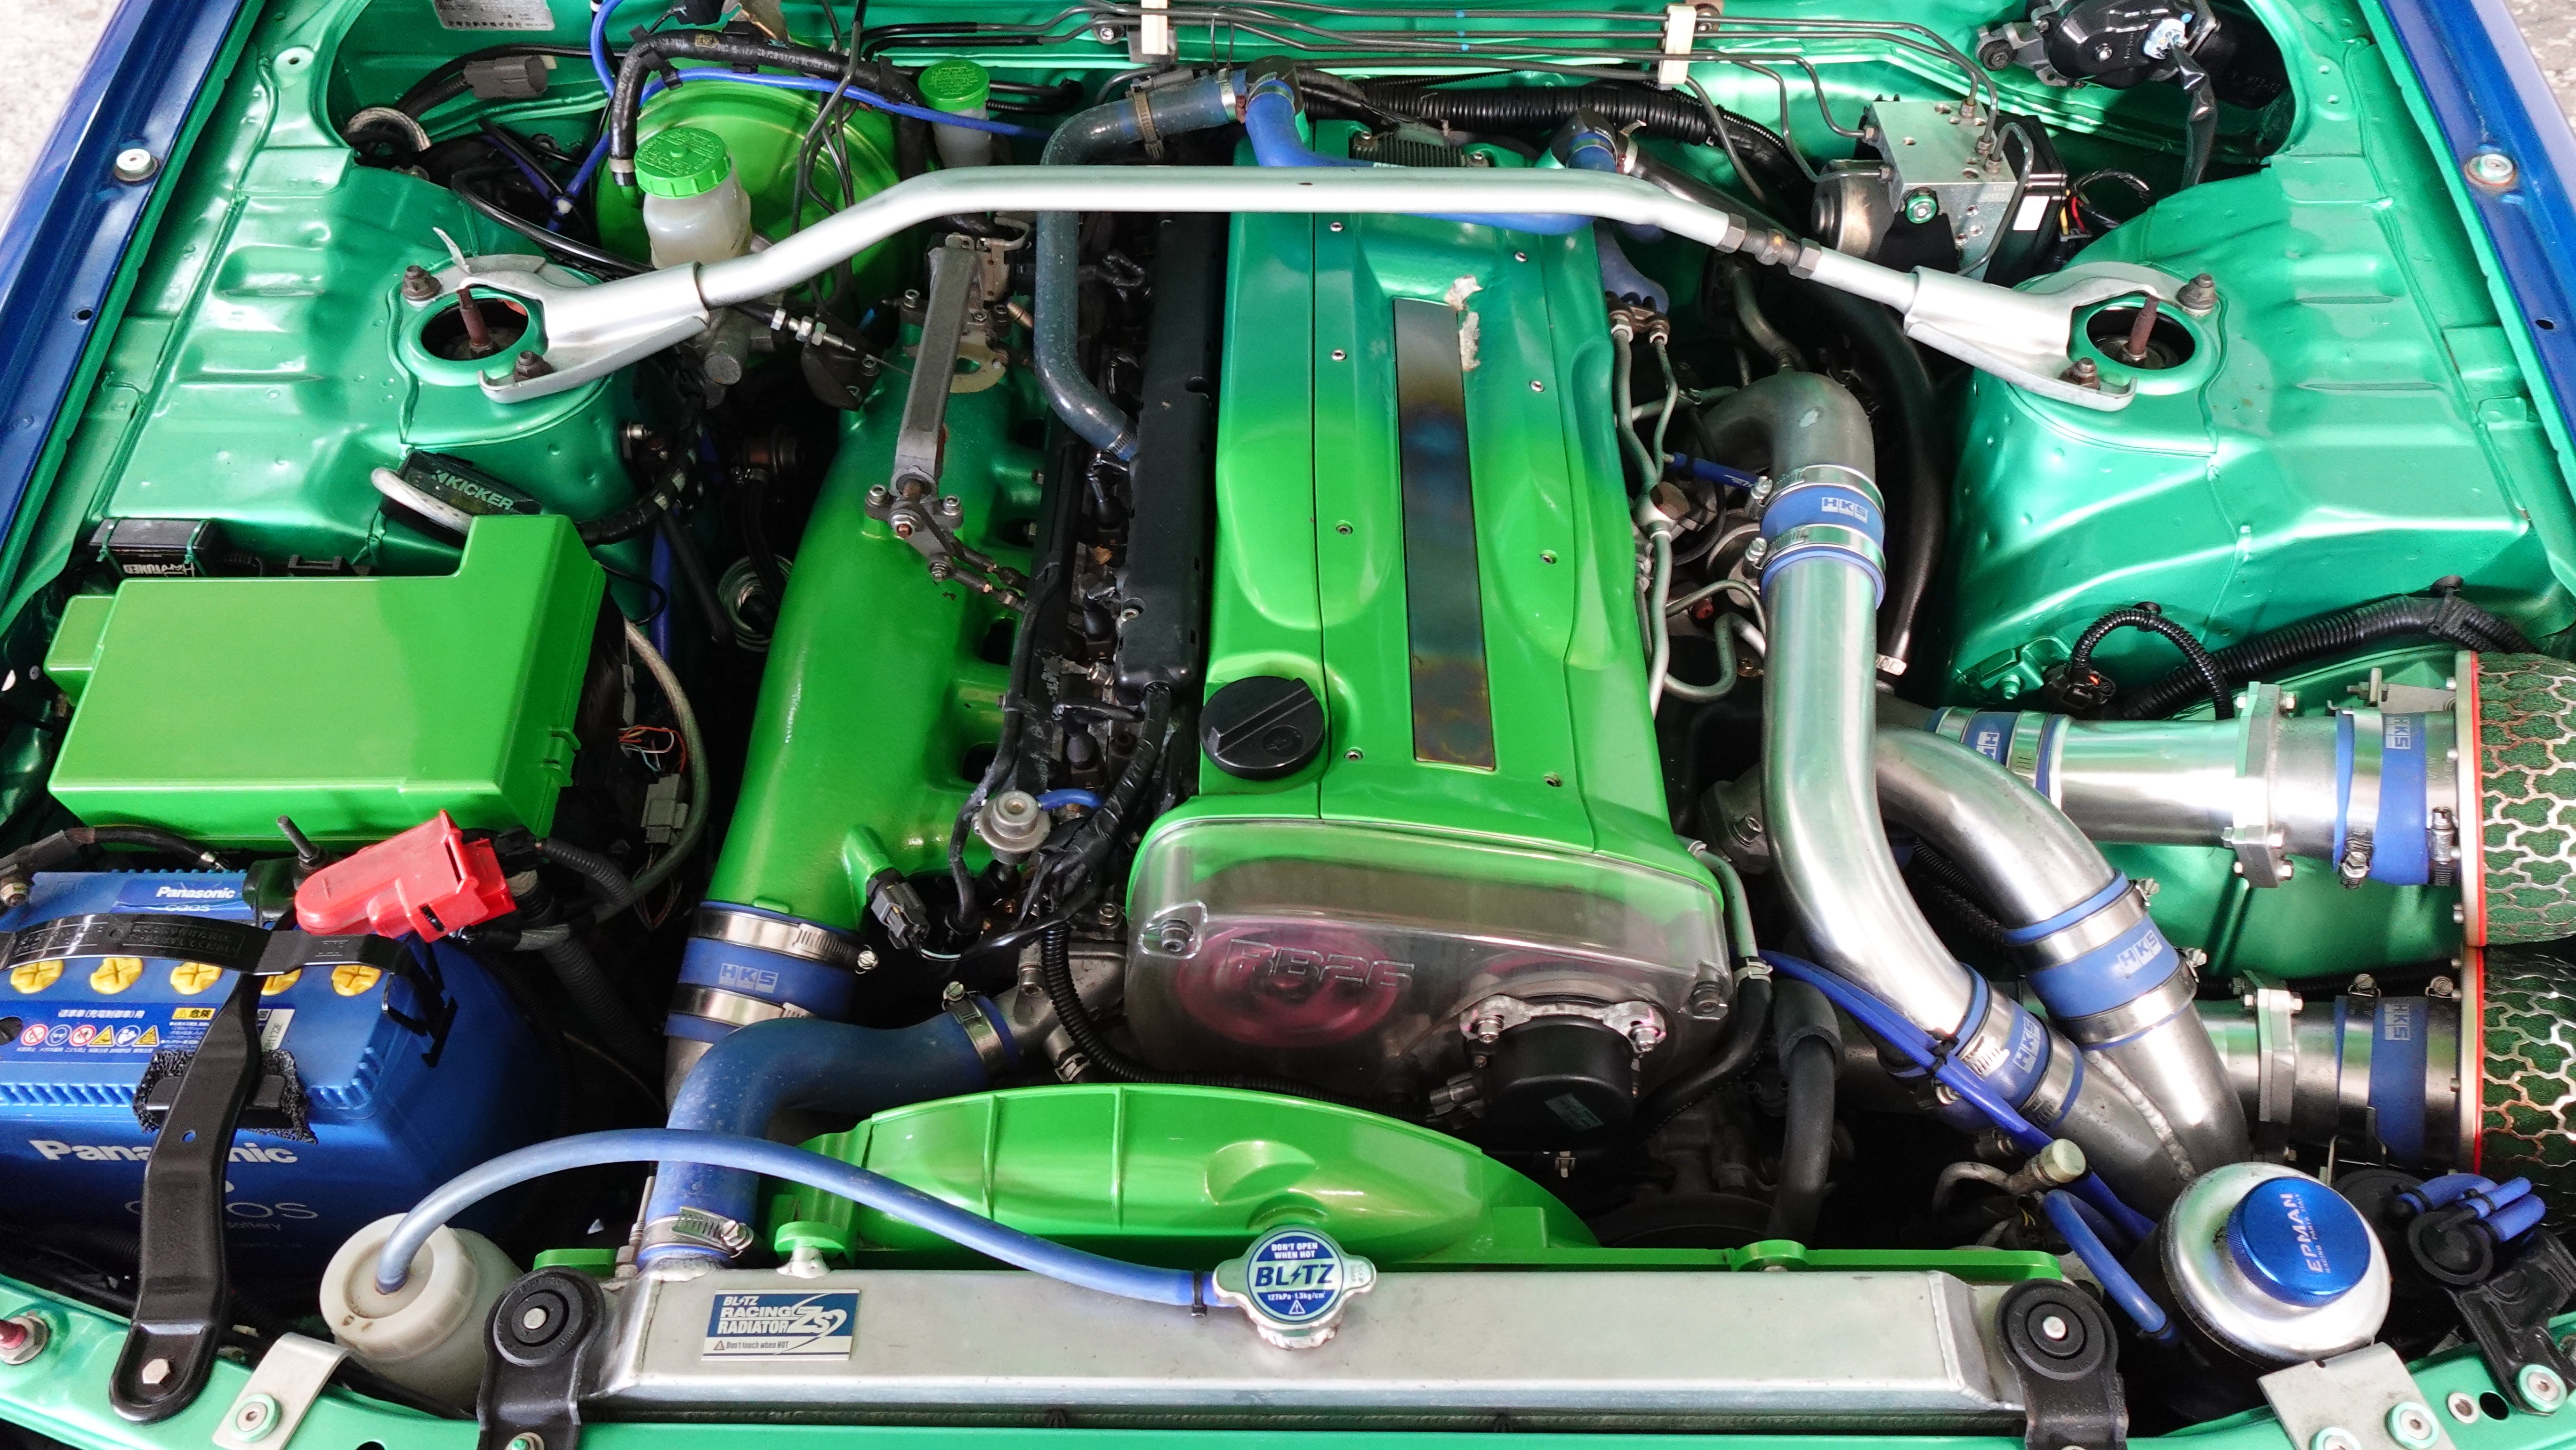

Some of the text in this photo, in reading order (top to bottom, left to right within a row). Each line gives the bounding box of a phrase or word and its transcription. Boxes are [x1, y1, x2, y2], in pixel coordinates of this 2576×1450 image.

[445, 475, 514, 511] KICKER
[1821, 497, 1868, 523] HKS
[1976, 732, 2000, 760] HK
[2385, 716, 2411, 749] HKS
[156, 886, 235, 899] Panasonic
[1225, 938, 1415, 988] RB26
[2117, 930, 2163, 975] HKS
[719, 963, 778, 993] HKS
[2384, 1004, 2411, 1041] HKS
[2013, 1015, 2041, 1073] HKS
[29, 1140, 298, 1164] Pananic
[1272, 1242, 1318, 1251] DON'T OPEN
[2279, 1193, 2324, 1273] EPMAN
[2294, 1193, 2332, 1274] RACING PARTS ITALY
[1255, 1264, 1335, 1287] BLITZ
[721, 1306, 792, 1317] RACING
[723, 1296, 759, 1306] BLITZ
[717, 1321, 789, 1334] RADIATOR
